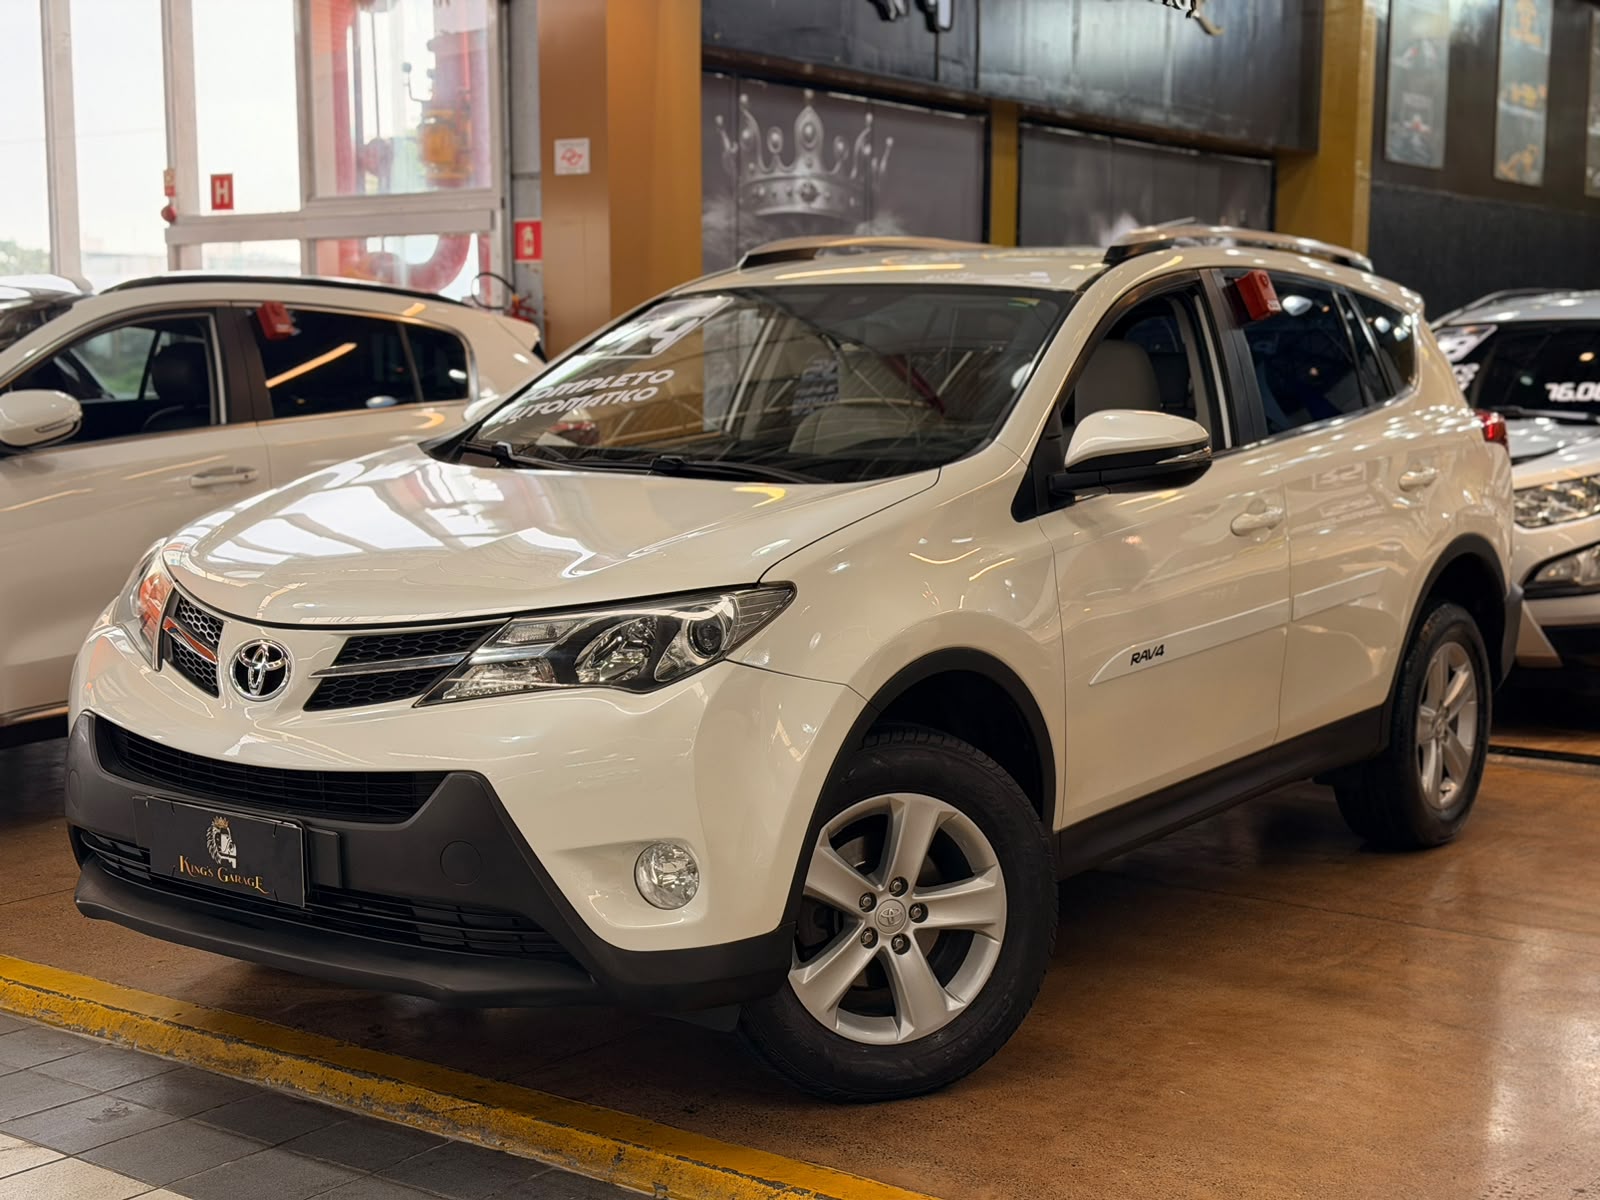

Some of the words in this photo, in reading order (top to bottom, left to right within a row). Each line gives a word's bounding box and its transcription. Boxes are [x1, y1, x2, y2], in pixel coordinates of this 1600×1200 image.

[215, 180, 229, 204] H
[1130, 644, 1164, 666] RAV4
[179, 855, 214, 878] KING'S
[217, 867, 269, 894] GARAGE
